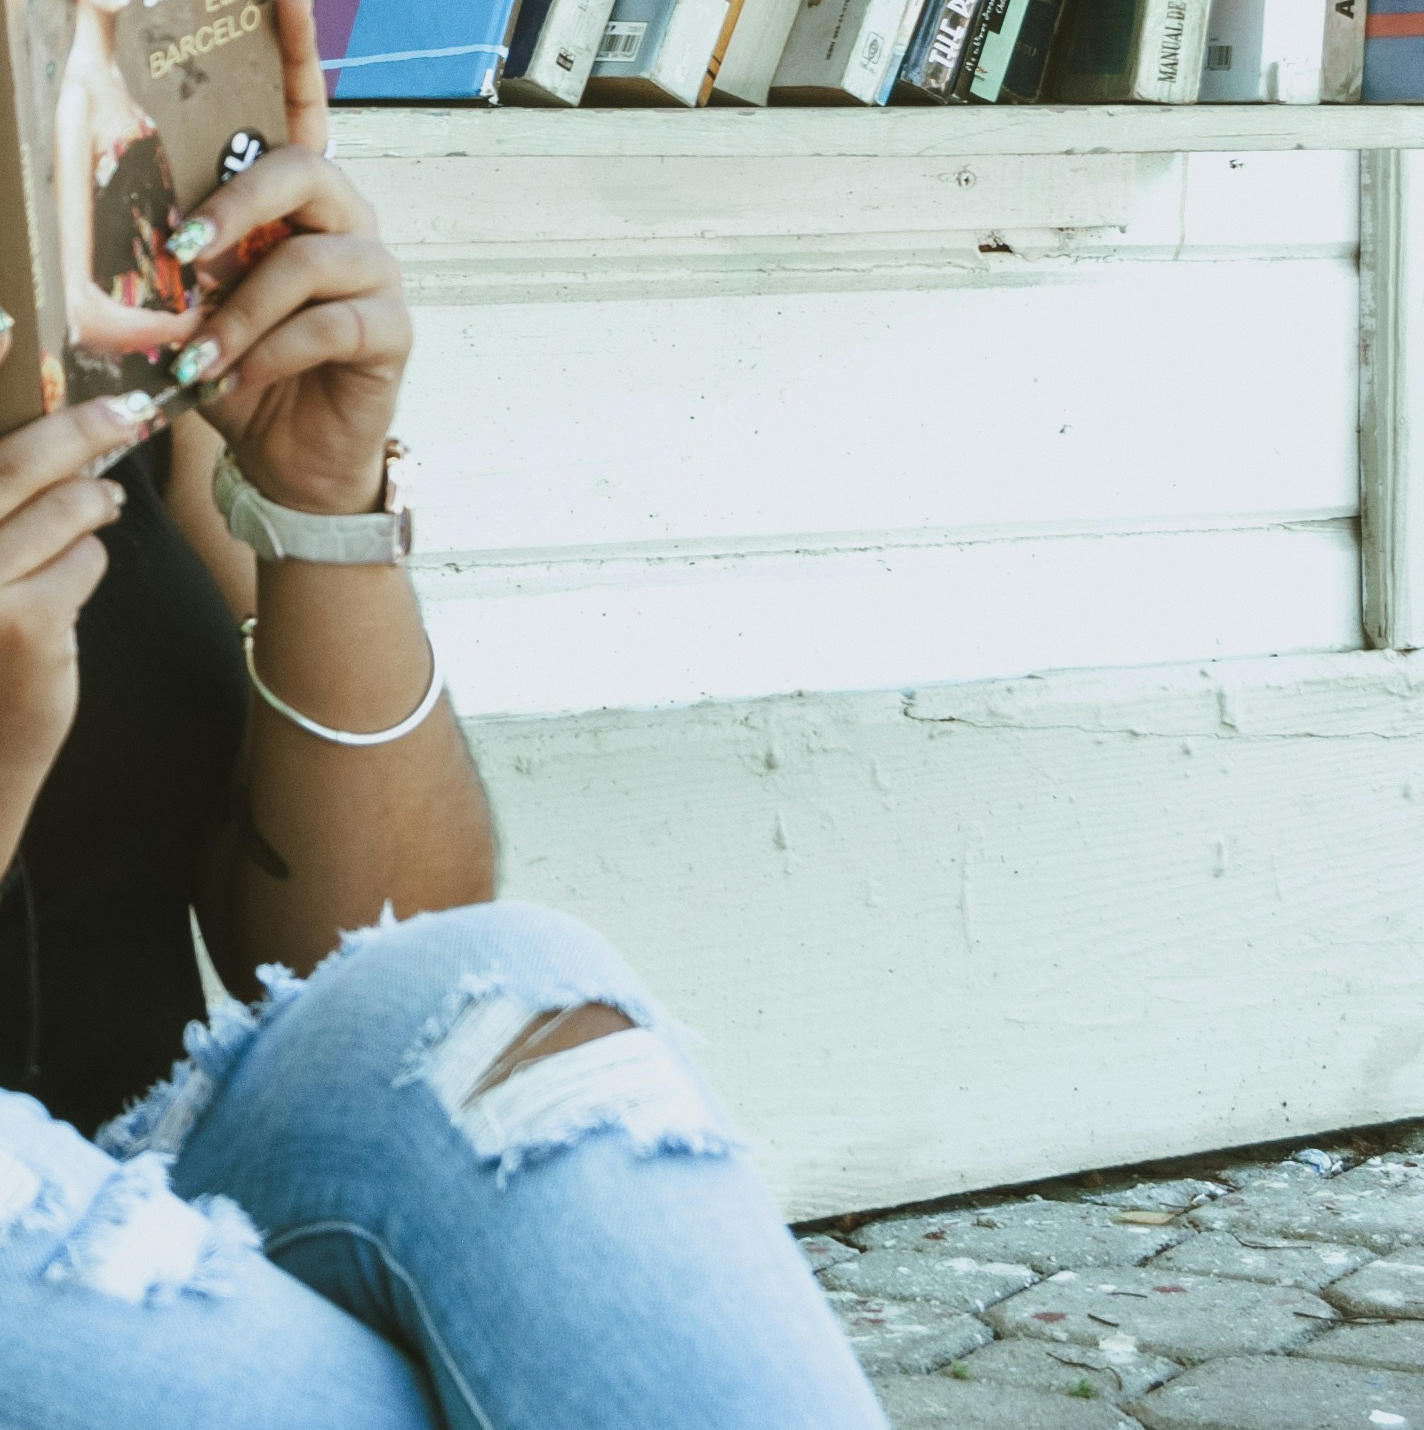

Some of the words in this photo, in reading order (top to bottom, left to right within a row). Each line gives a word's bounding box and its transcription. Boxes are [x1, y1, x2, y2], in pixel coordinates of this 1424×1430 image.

[148, 0, 262, 80] BARCELÓ
[1168, 0, 1188, 21] DE
[1157, 20, 1185, 85] MANUAL
